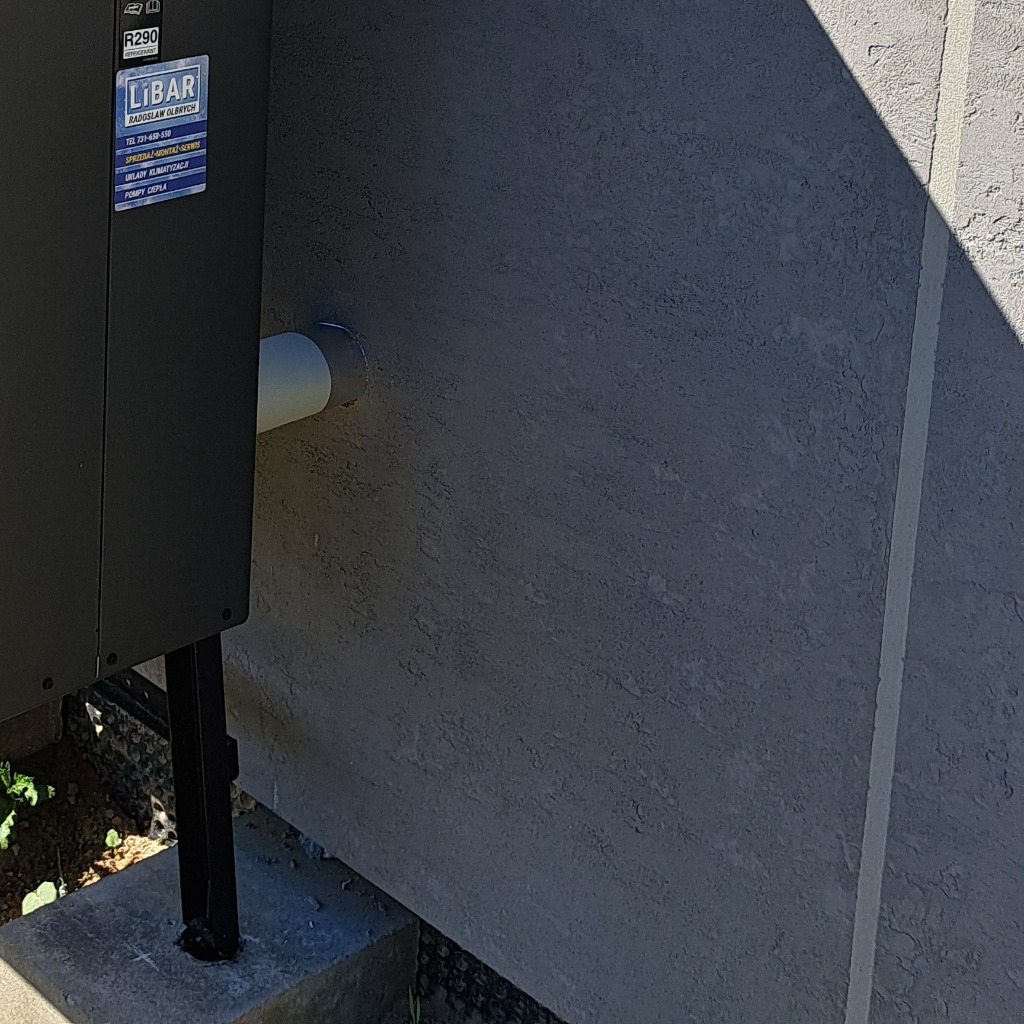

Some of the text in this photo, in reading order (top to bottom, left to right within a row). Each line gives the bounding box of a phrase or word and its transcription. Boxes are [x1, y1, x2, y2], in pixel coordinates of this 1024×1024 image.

[124, 29, 158, 47] R290
[166, 103, 196, 116] OLBRYCH
[124, 187, 145, 200] POMPY
